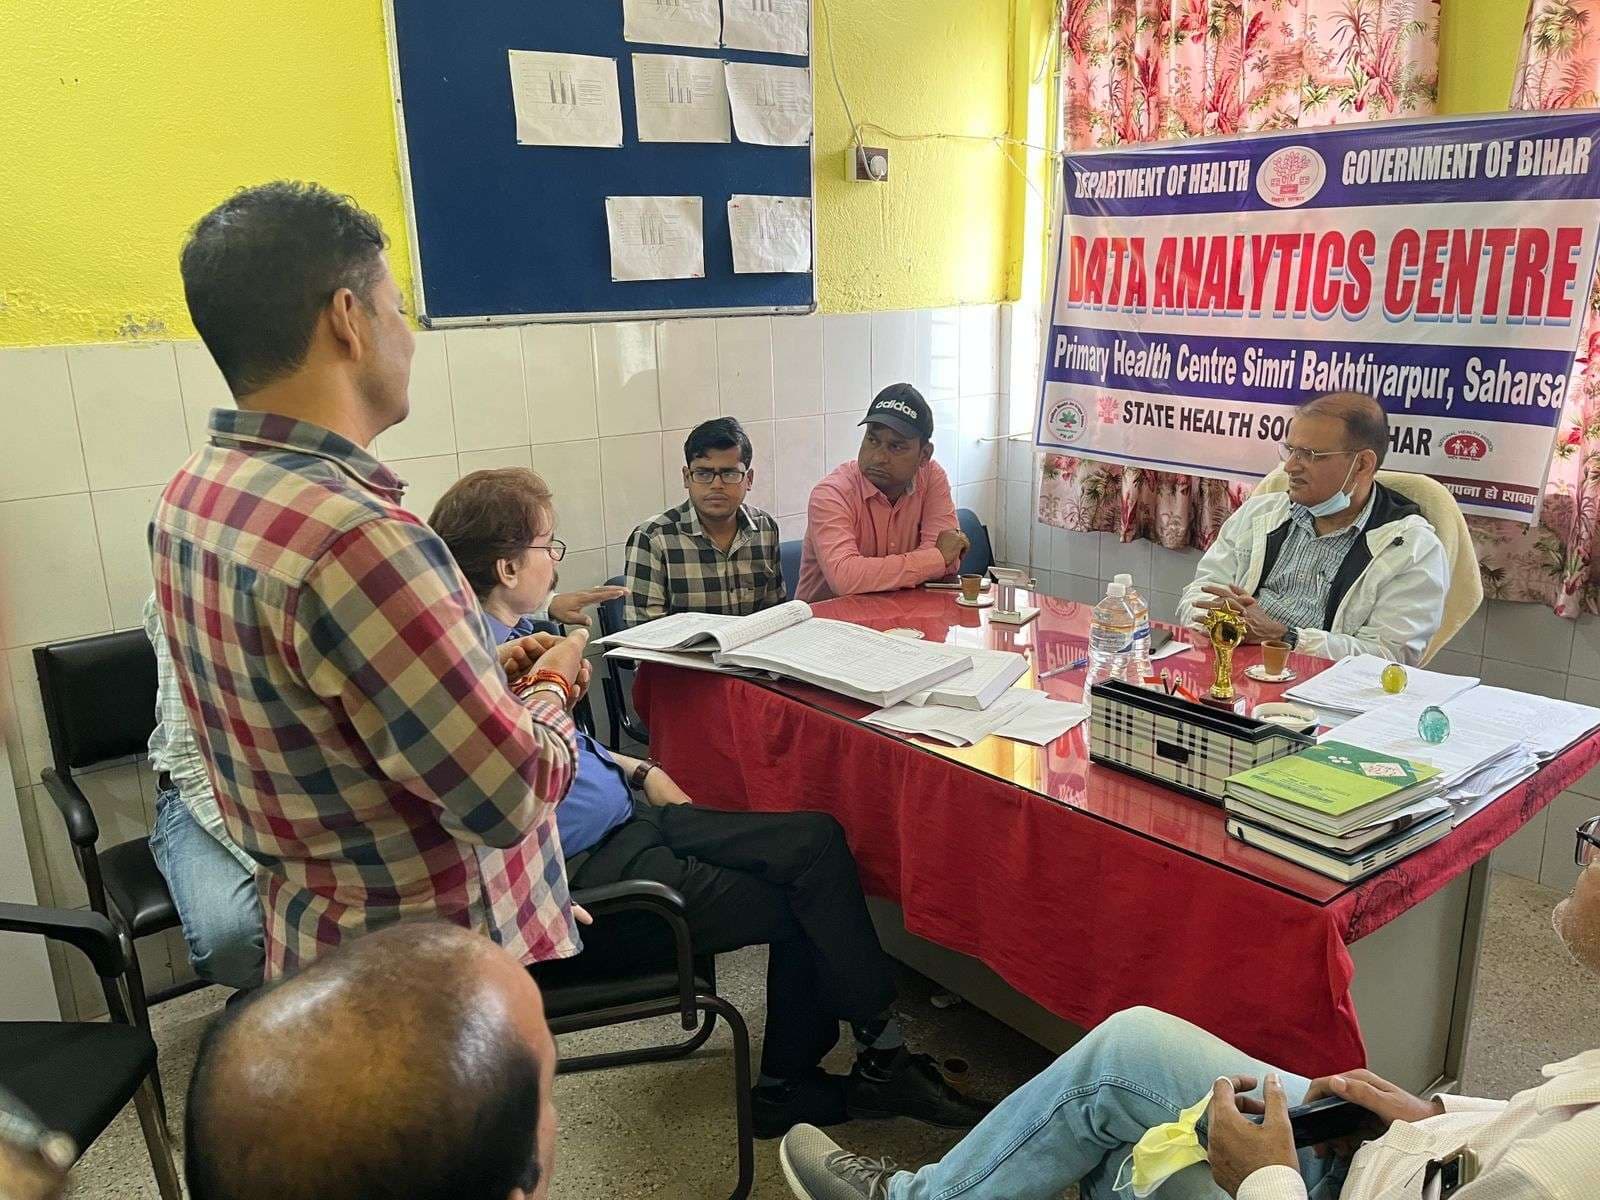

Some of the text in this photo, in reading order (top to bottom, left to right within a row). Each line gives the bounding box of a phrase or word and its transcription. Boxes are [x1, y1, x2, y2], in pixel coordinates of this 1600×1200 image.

[1074, 159, 1250, 199] DEPARTMENT OF HEALTH
[1342, 137, 1592, 185] GOVERNMENT OF BIHAR
[1068, 228, 1583, 326] DATA ANALYTICS CENTRE
[1054, 334, 1567, 409] Primary Health Centre Simri Bakhtiyarpur, Saharsa
[875, 400, 918, 419] adidas
[1123, 400, 1174, 429] STATE
[1180, 407, 1254, 438] HEALTH
[1388, 425, 1433, 457] HAR
[1485, 485, 1499, 500] हो
